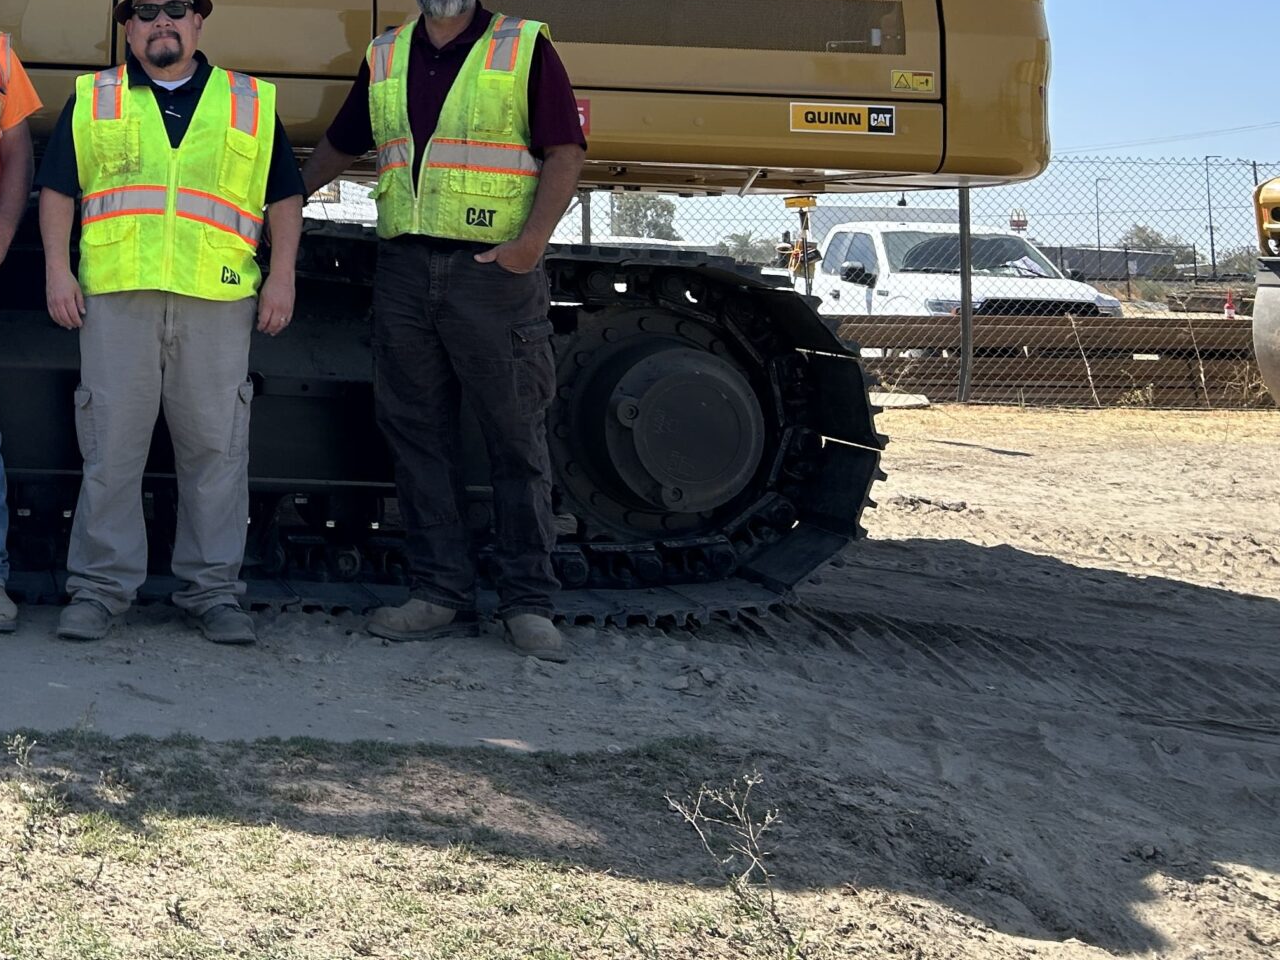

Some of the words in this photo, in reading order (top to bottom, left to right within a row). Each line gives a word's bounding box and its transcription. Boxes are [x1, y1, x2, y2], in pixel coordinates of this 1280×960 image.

[804, 110, 862, 126] QUINN
[870, 113, 892, 127] CAT
[465, 207, 497, 228] CAT
